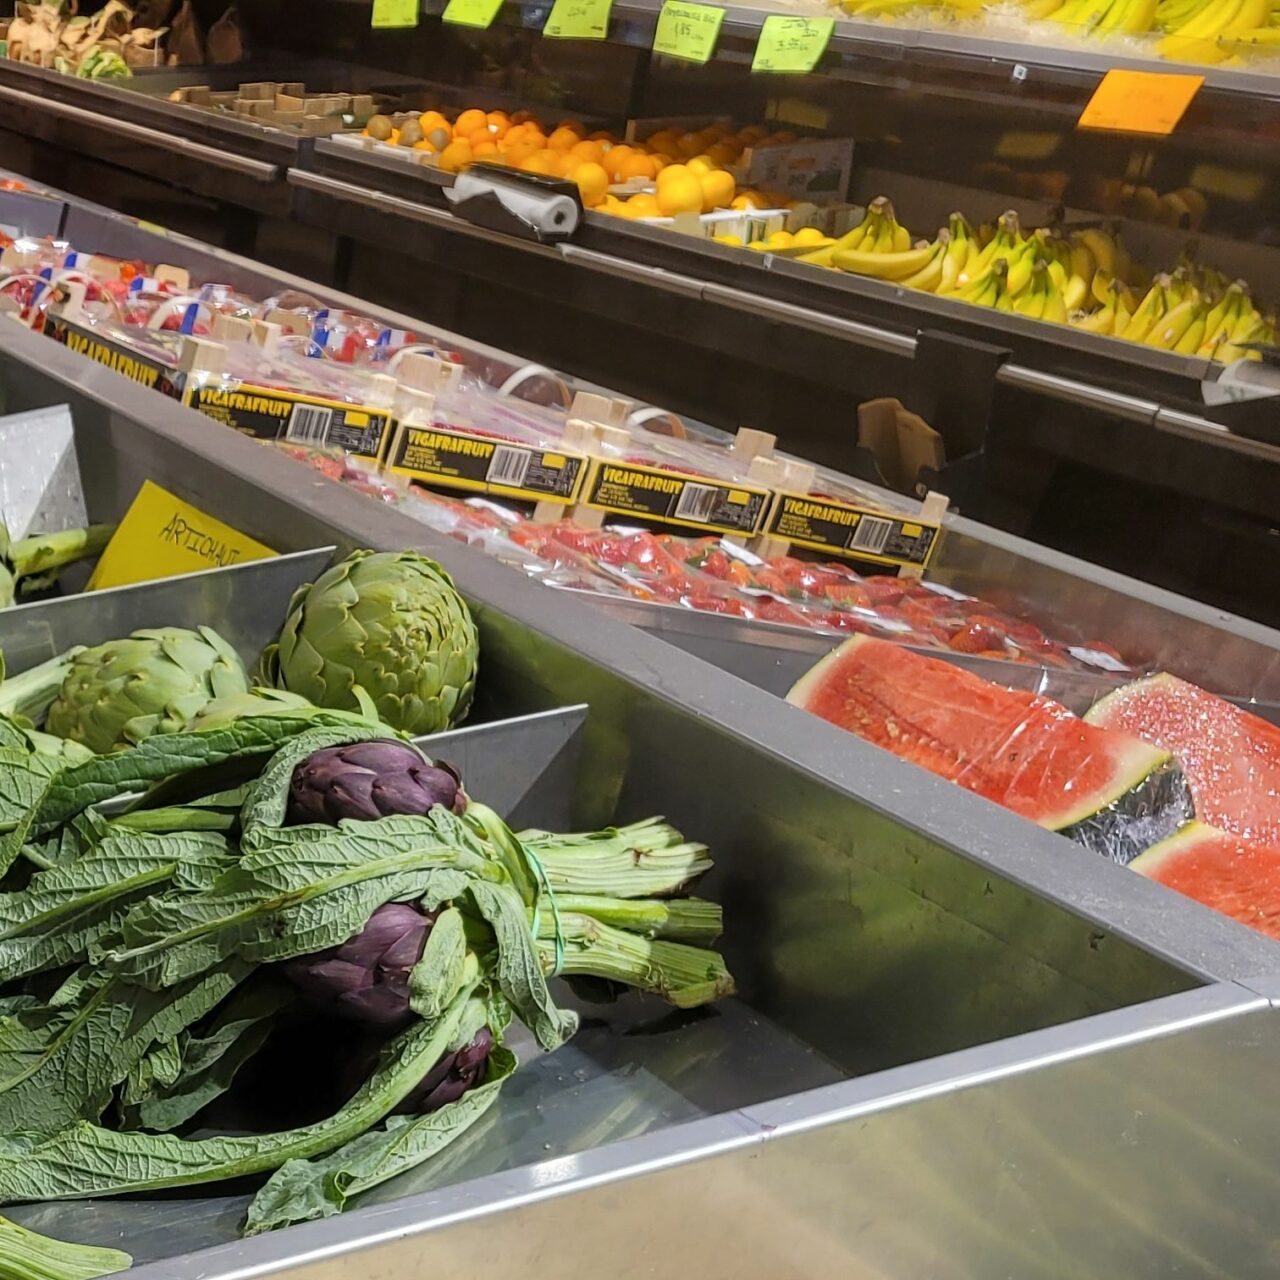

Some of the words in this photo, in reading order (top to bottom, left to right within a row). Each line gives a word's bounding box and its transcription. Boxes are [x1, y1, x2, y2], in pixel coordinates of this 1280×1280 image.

[67, 330, 159, 388] VIGAFRAFRUIT
[199, 388, 293, 418] VIGAFRAFRUIT
[407, 429, 496, 459] VIGAFRAFRUIT
[602, 467, 684, 495] VIGAFRAFRUIT
[783, 498, 861, 527] VIGAFRAFRUIT
